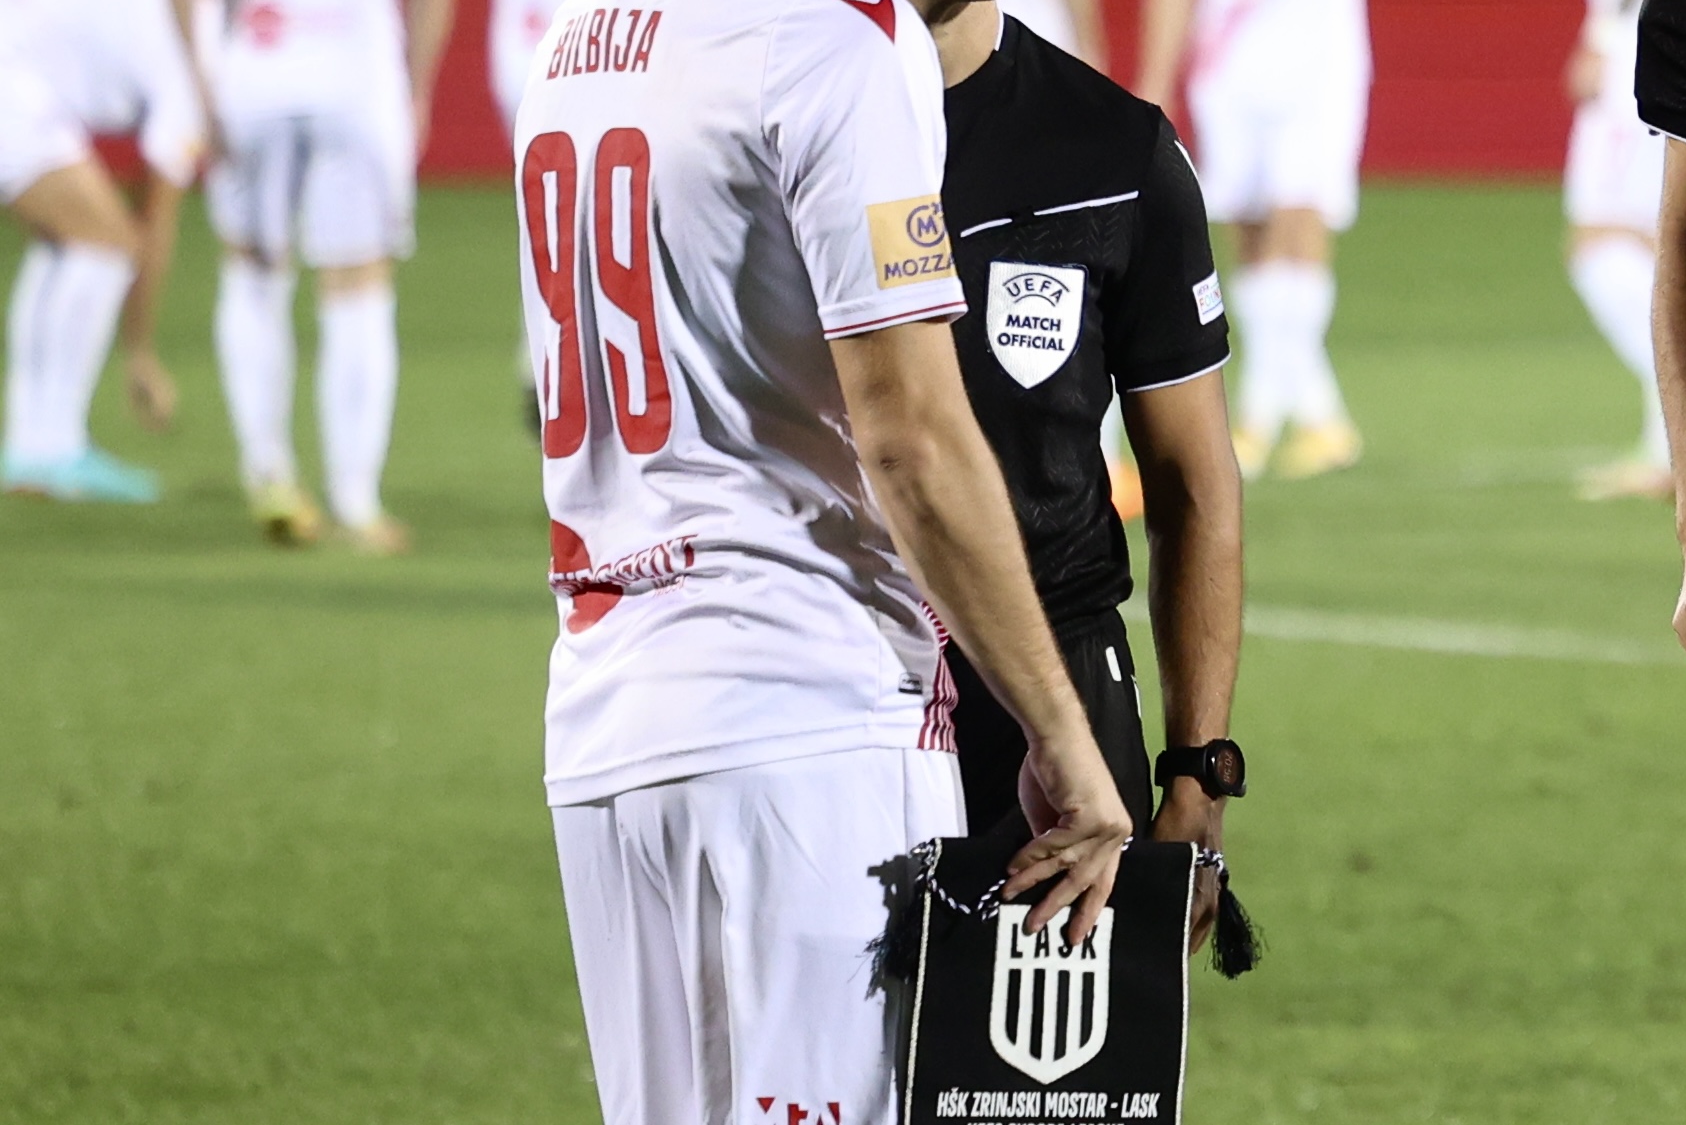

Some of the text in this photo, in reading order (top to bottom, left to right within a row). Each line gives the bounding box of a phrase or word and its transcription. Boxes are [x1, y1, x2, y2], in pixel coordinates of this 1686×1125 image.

[546, 8, 663, 80] BILBIJA
[1006, 278, 1063, 303] UEFA
[1006, 314, 1061, 332] MATCH
[997, 332, 1065, 351] OFFICIAL
[1010, 922, 1097, 960] LASK
[936, 1086, 970, 1118] HŠK
[970, 1091, 1041, 1118] ZRINJSKI
[1044, 1091, 1108, 1118] MOSTAR
[1121, 1092, 1161, 1118] LASK
